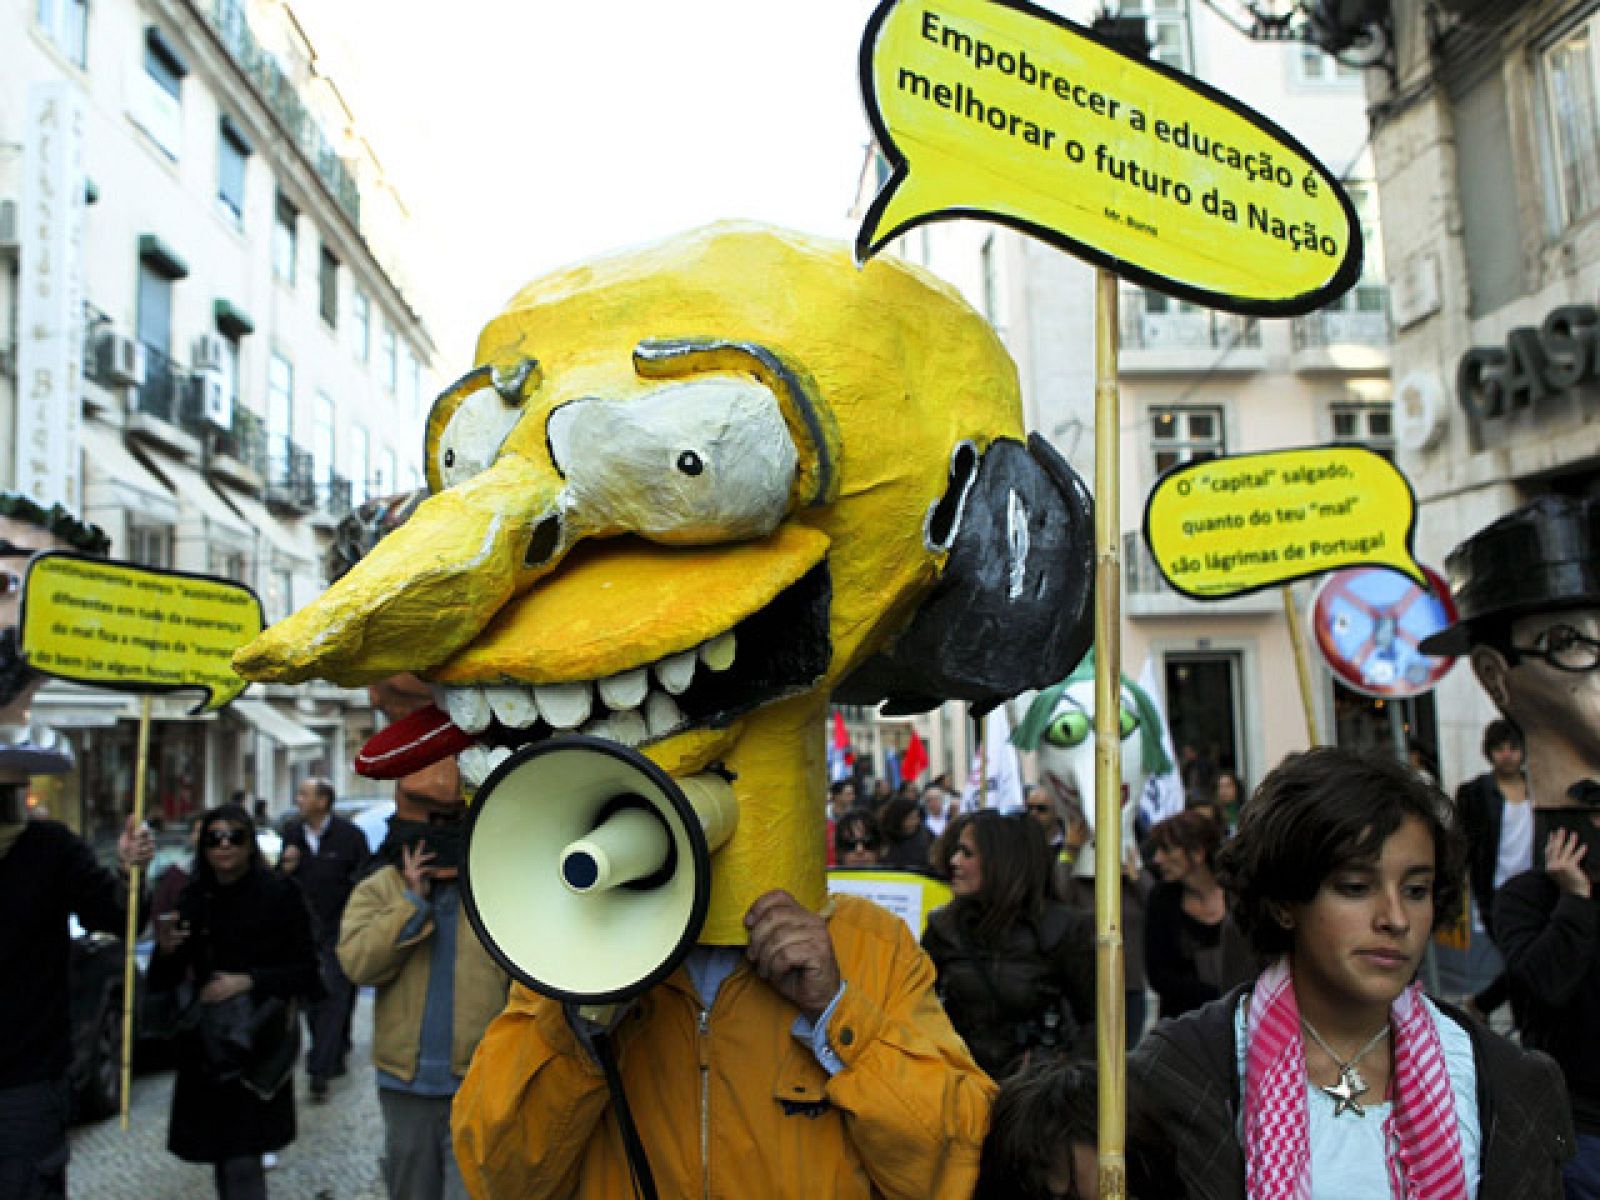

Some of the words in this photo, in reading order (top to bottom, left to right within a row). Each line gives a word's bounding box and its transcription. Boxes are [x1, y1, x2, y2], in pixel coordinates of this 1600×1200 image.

[898, 67, 1056, 150] melhorar
[1066, 139, 1084, 163] o
[1094, 144, 1192, 206] futuro
[1202, 188, 1238, 222] da
[1247, 205, 1338, 258] Nação
[922, 12, 1119, 121] Empobrecer
[1130, 108, 1146, 132] a
[1154, 121, 1293, 187] educação
[1303, 163, 1319, 198] é
[1171, 557, 1200, 575] são
[1205, 546, 1279, 572] lágrimas
[1283, 543, 1305, 561] de
[1310, 531, 1386, 556] Portugal
[1182, 512, 1245, 536] quanto
[1250, 509, 1271, 526] do
[1276, 507, 1306, 522] teu
